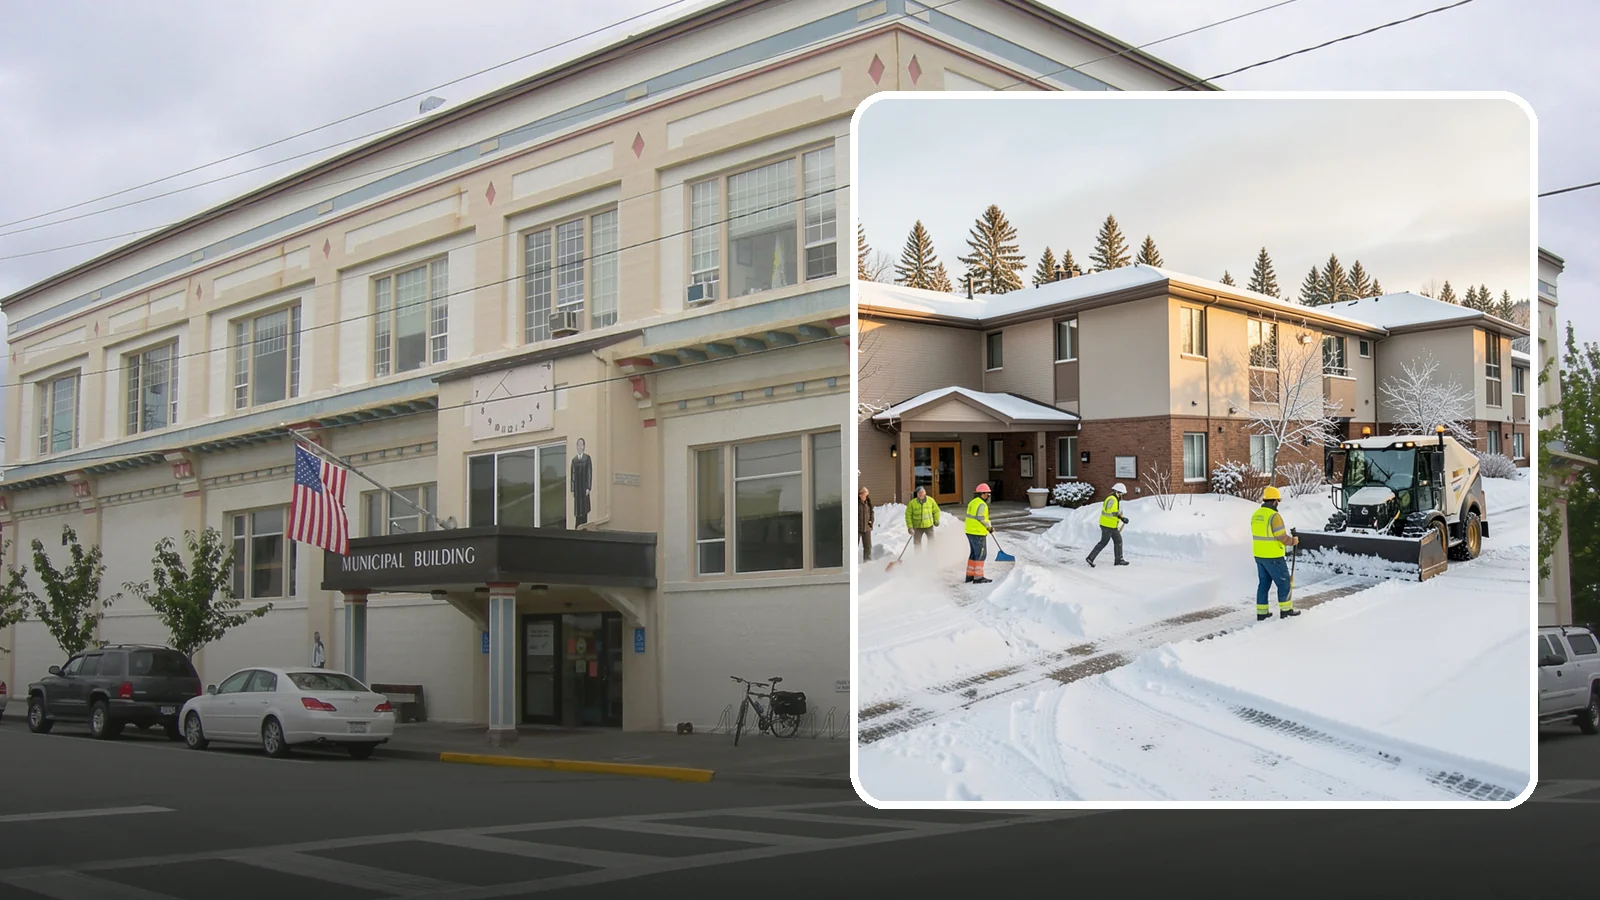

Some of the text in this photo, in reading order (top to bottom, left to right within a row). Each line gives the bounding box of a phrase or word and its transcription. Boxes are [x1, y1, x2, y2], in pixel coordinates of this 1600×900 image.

[487, 418, 492, 426] 9
[494, 424, 500, 432] 10
[507, 425, 513, 433] 12
[342, 546, 475, 572] MUNICIPAL BUILDING
